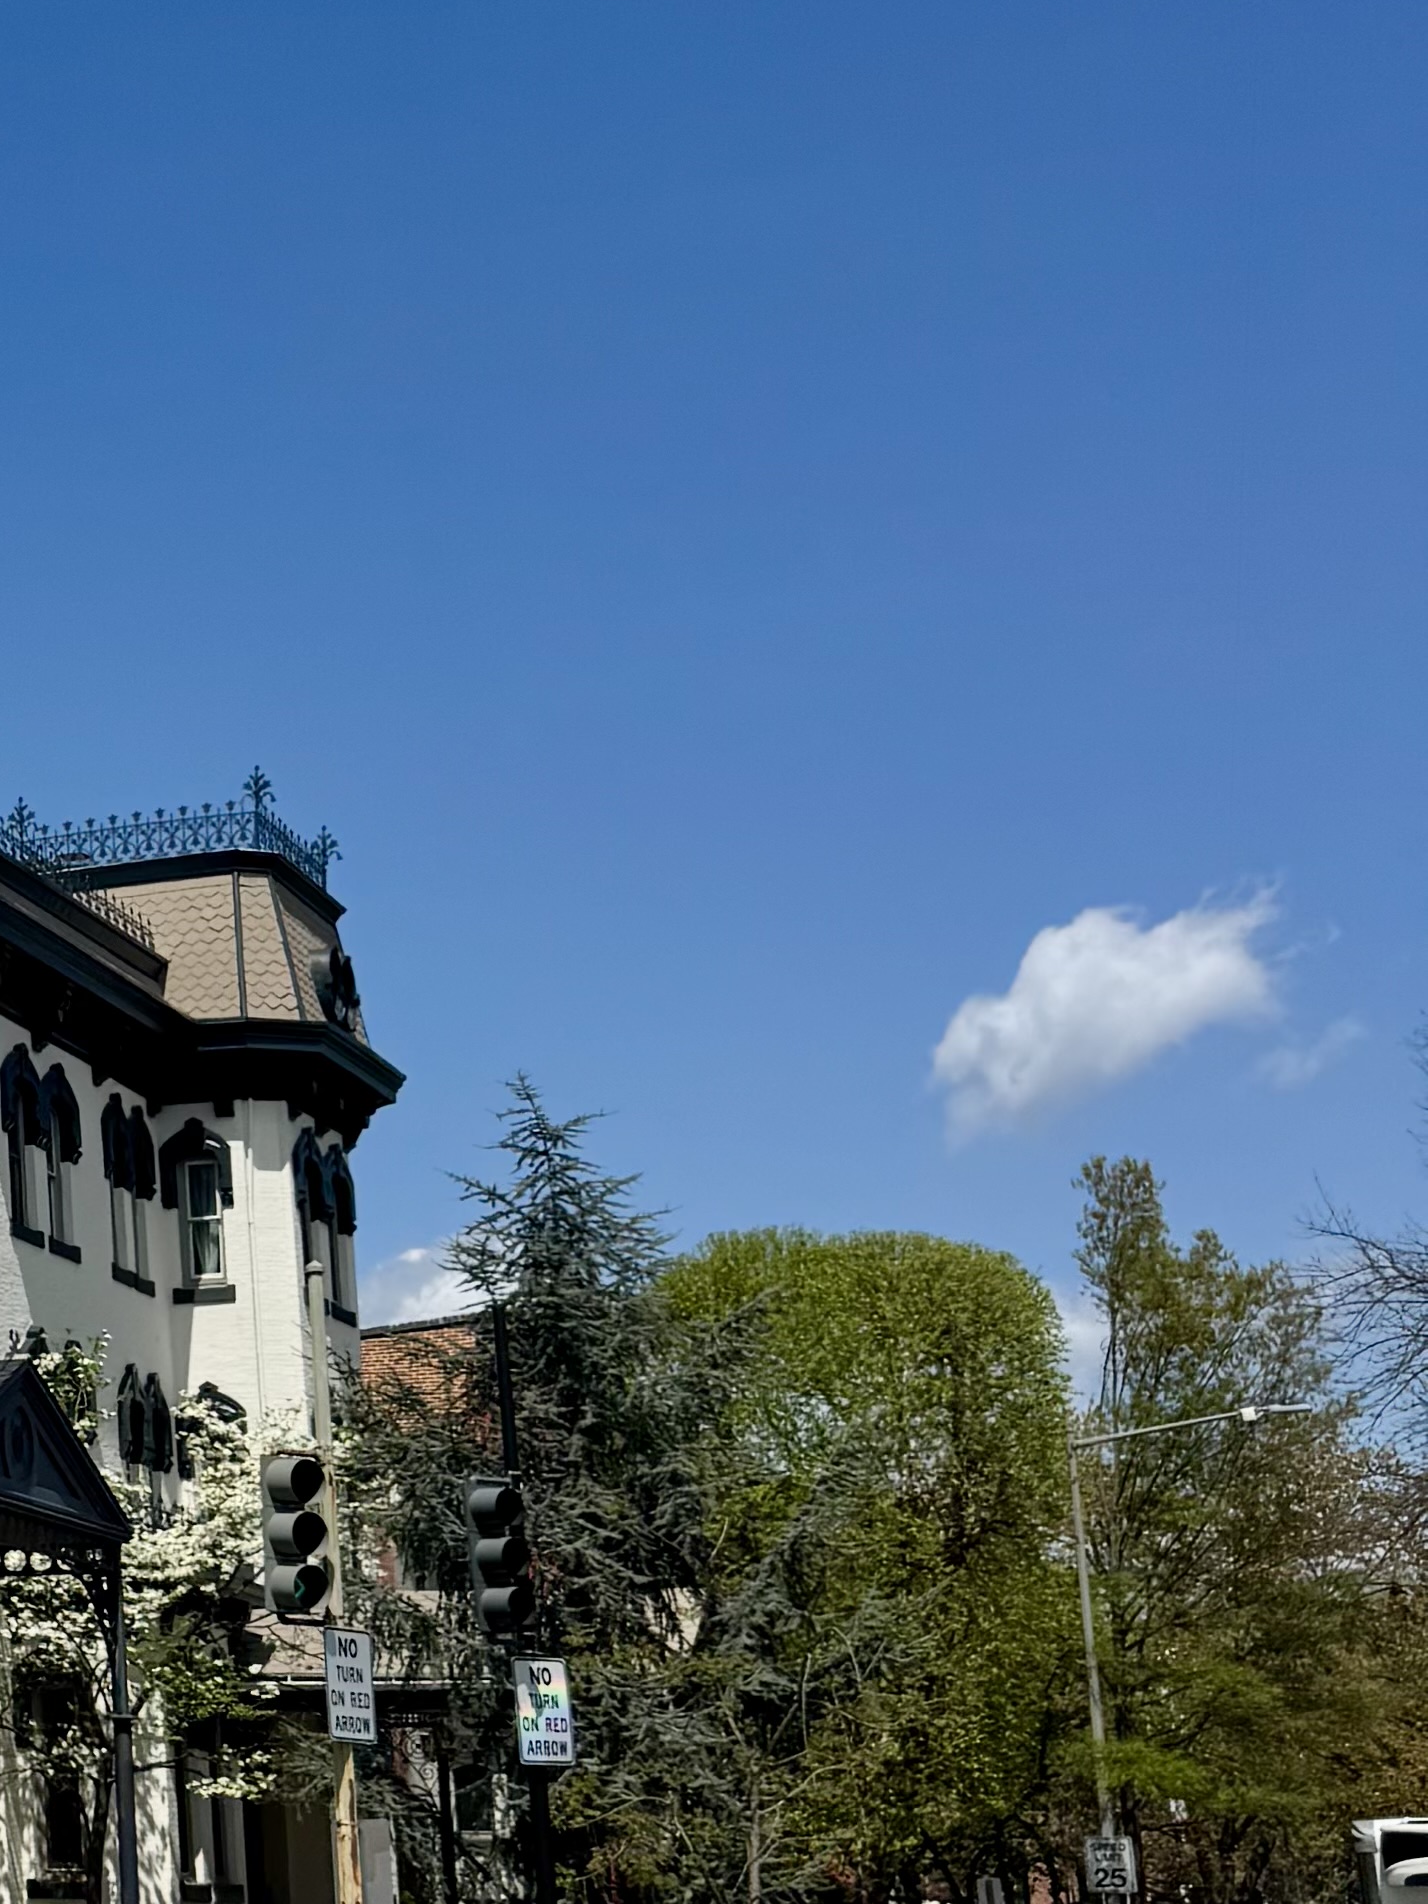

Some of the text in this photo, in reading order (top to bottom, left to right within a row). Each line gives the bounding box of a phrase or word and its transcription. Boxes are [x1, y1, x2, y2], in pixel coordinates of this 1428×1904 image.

[337, 1636, 358, 1658] NO
[336, 1664, 364, 1683] TURN
[528, 1666, 552, 1686] NO
[330, 1689, 370, 1709] ON RED
[528, 1692, 560, 1709] TURN
[335, 1714, 371, 1735] ARROW
[522, 1716, 568, 1733] ON RED
[527, 1740, 568, 1756] ARROW
[1094, 1868, 1127, 1888] 25
